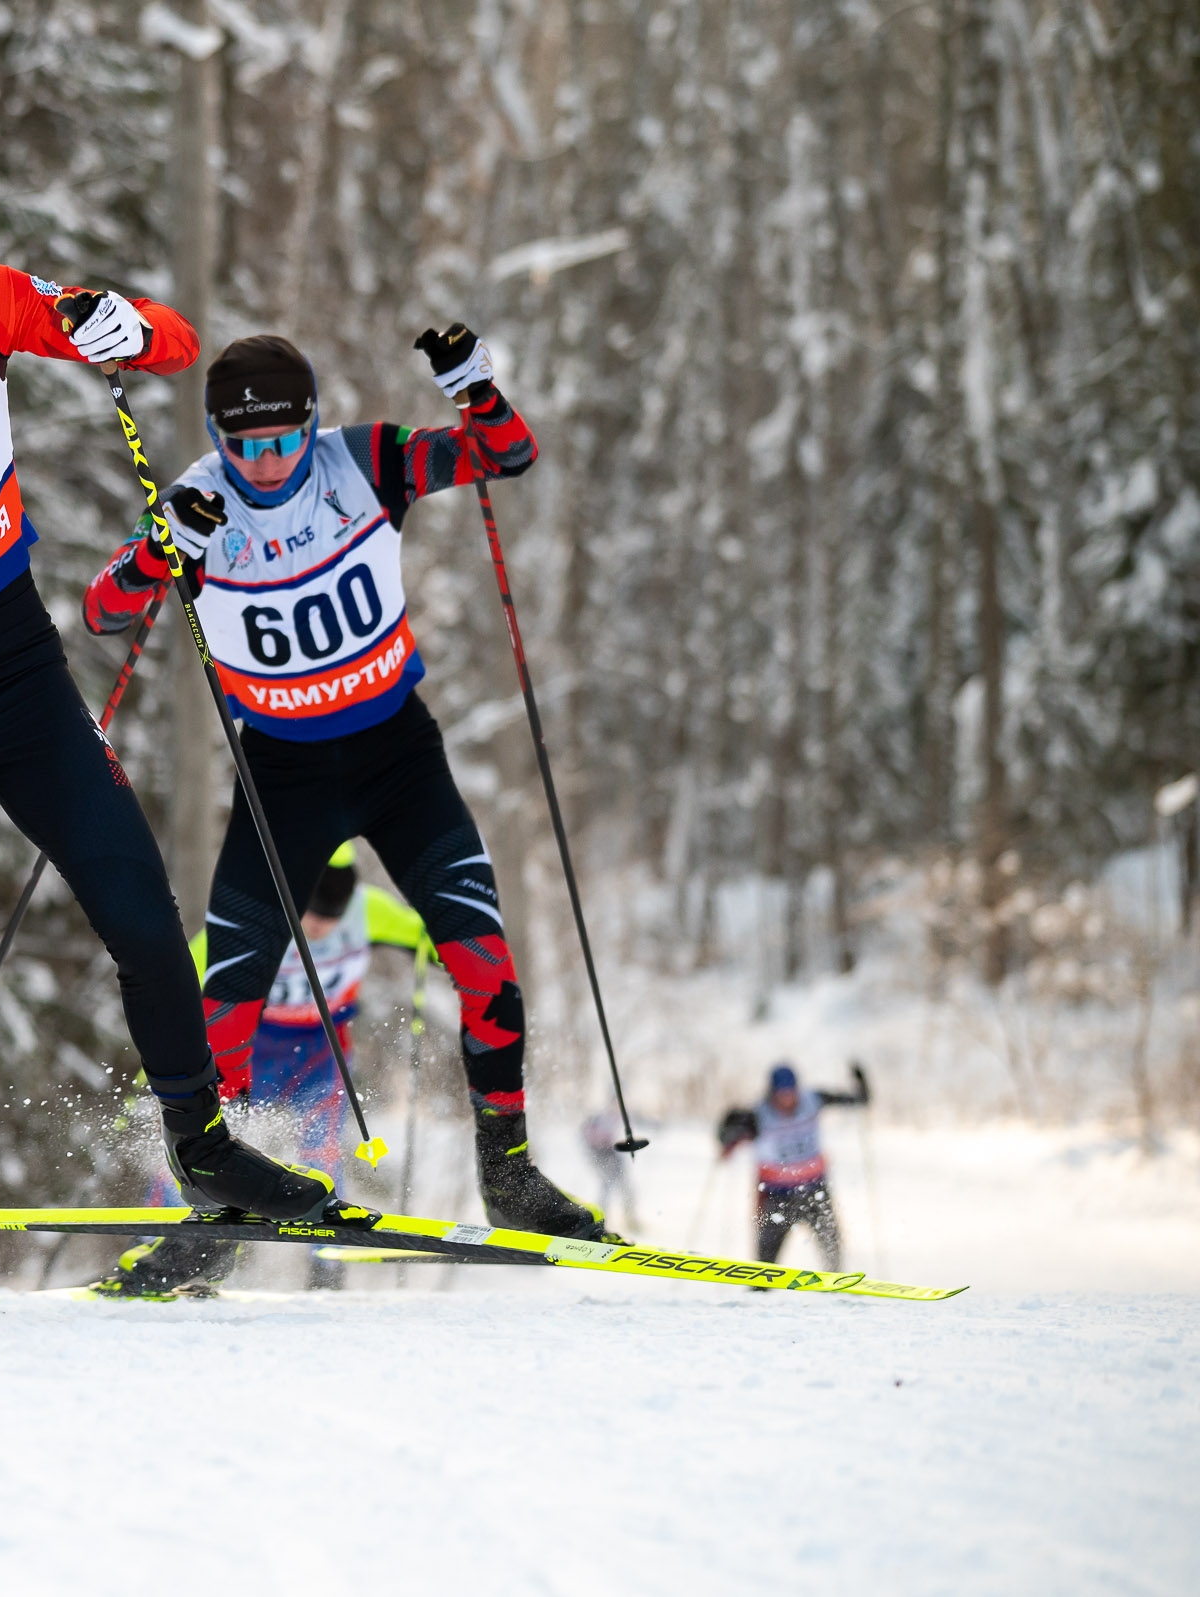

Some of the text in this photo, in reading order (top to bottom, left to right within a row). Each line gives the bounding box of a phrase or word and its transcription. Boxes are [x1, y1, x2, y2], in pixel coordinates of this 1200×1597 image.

[285, 525, 315, 553] ПСБ
[241, 563, 383, 667] 600
[248, 635, 406, 711] УДМУРТИЯ
[278, 1227, 336, 1238] FISCHER
[612, 1251, 786, 1283] FISCHER
